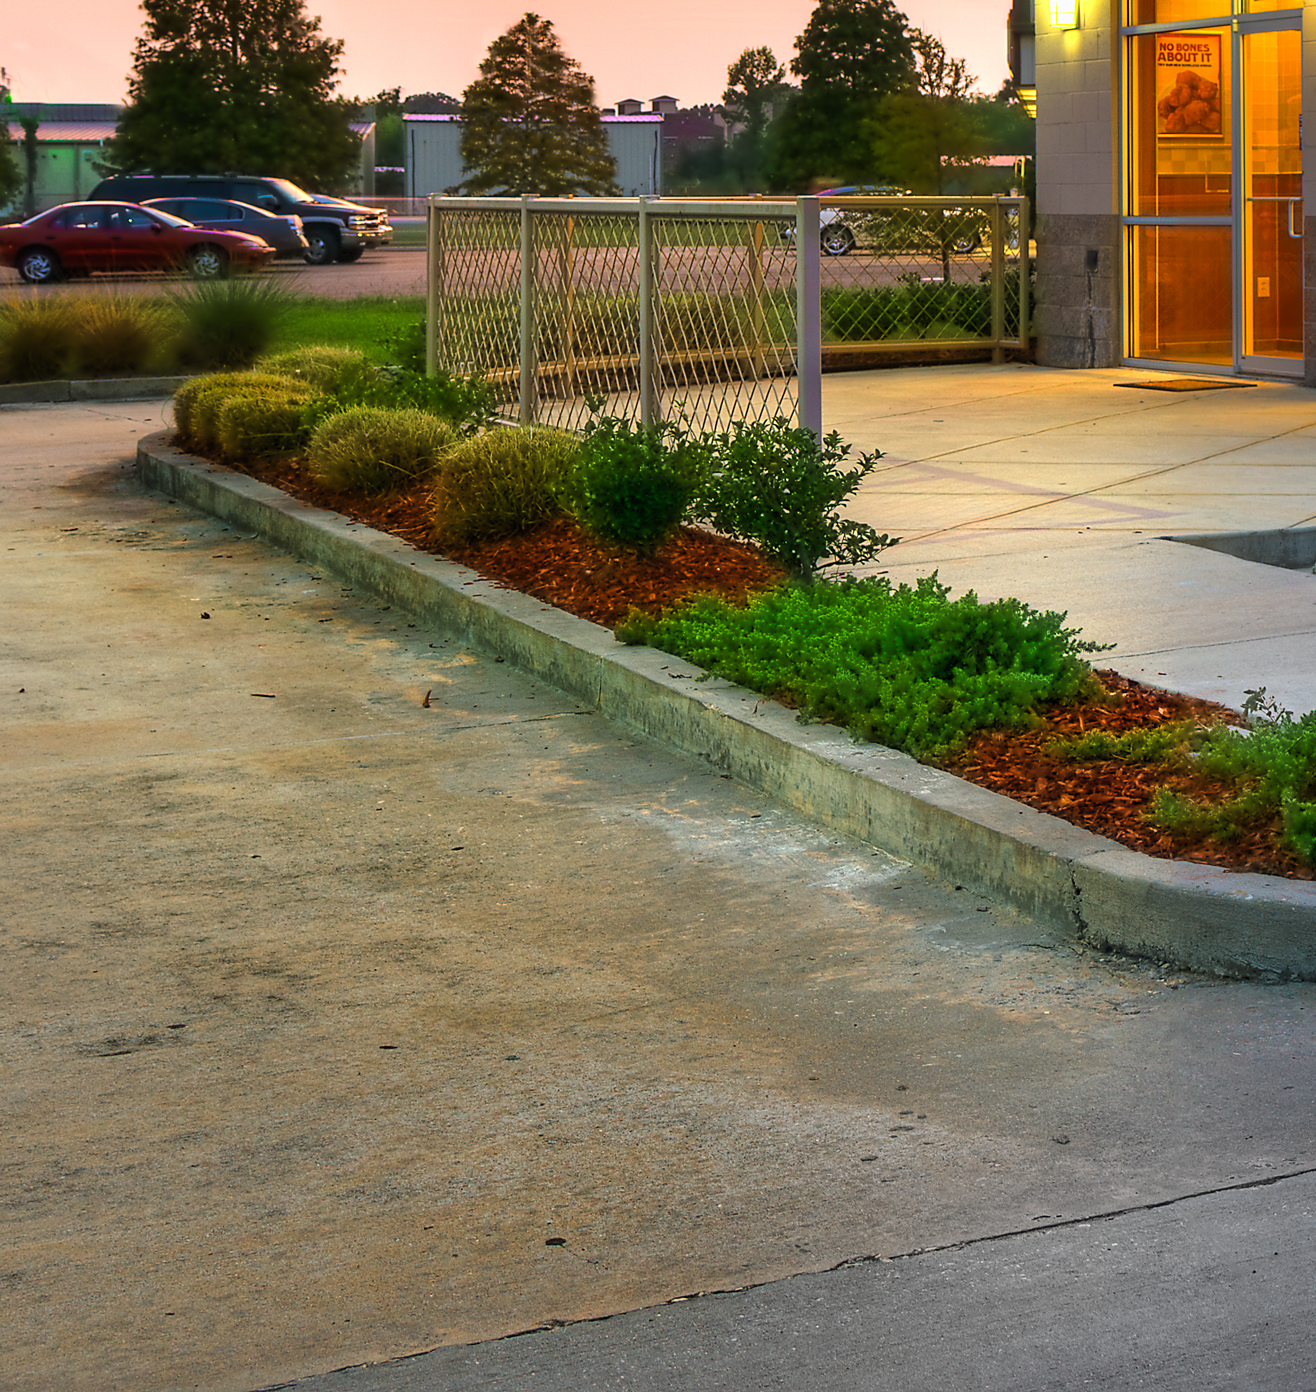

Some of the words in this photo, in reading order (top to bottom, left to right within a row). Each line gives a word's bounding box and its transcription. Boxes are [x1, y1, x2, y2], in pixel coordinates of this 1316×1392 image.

[1160, 42, 1174, 51] NO
[1176, 43, 1210, 52] BONES
[1157, 52, 1198, 62] ABOUT
[1201, 52, 1212, 62] IT
